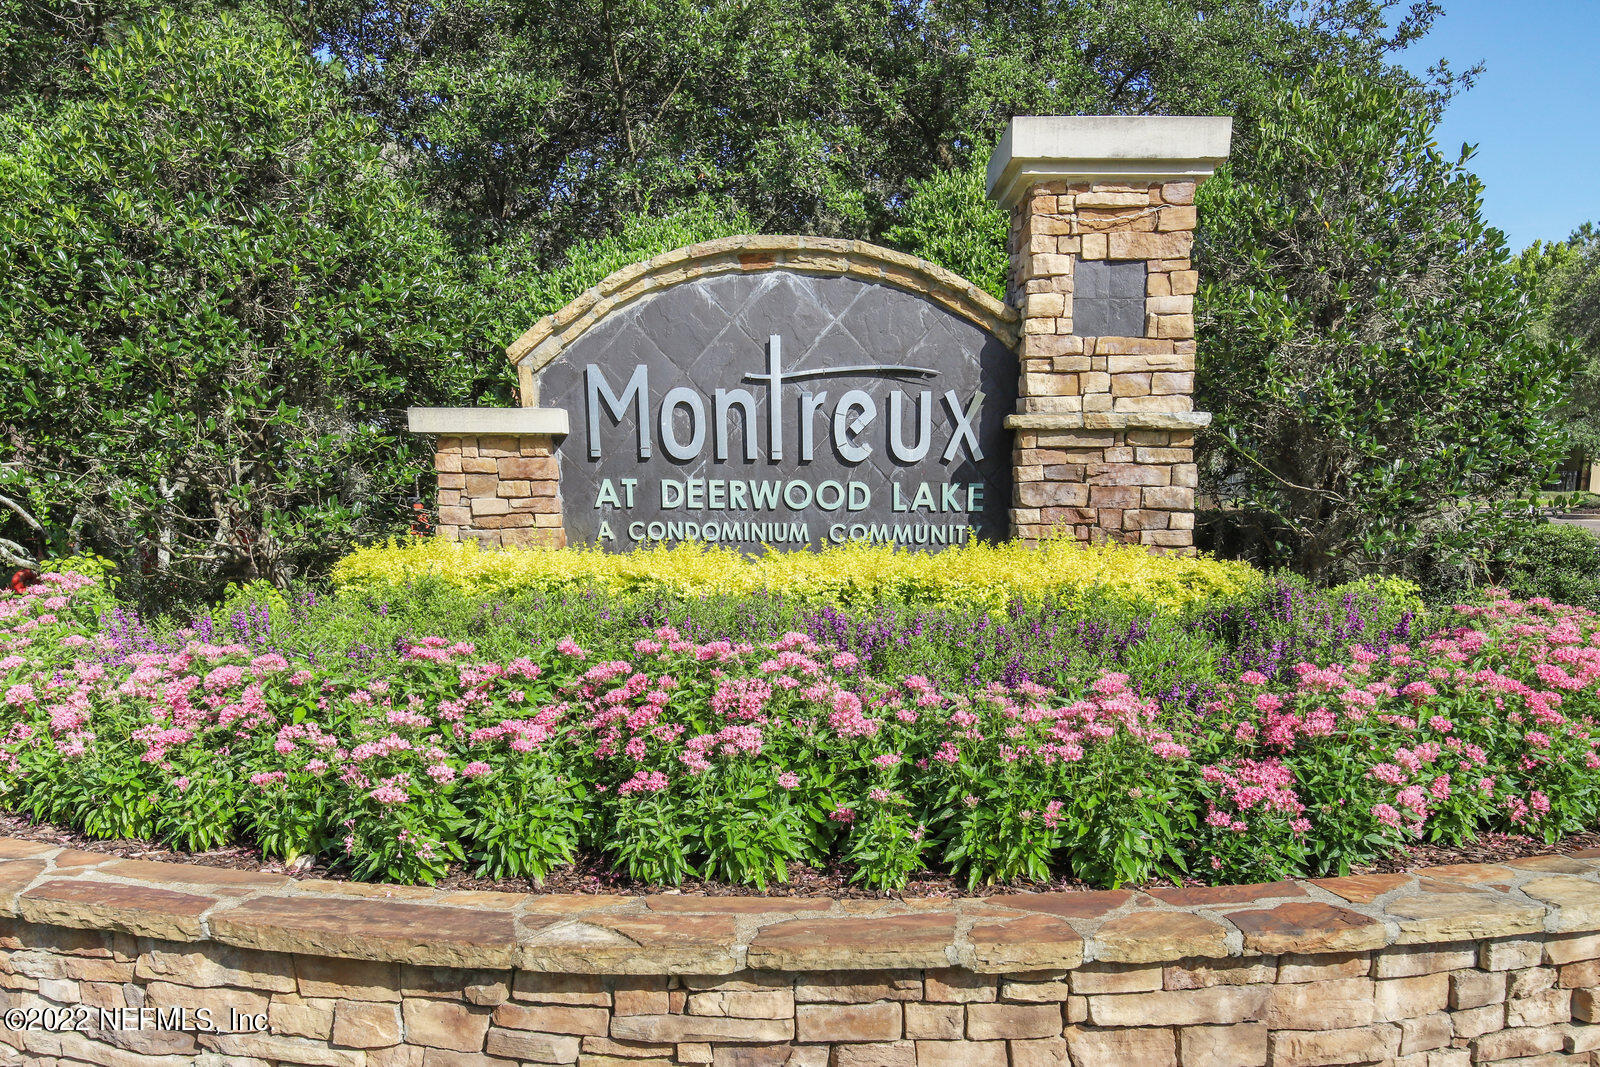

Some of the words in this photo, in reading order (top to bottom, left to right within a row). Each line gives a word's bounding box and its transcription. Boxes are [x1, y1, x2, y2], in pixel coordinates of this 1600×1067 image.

[586, 334, 986, 463] Montreux
[594, 478, 638, 509] AT
[660, 479, 871, 511] DEERWOOD
[892, 481, 984, 513] LAKE
[597, 520, 616, 541] A
[628, 521, 810, 543] CONDOMINIUM
